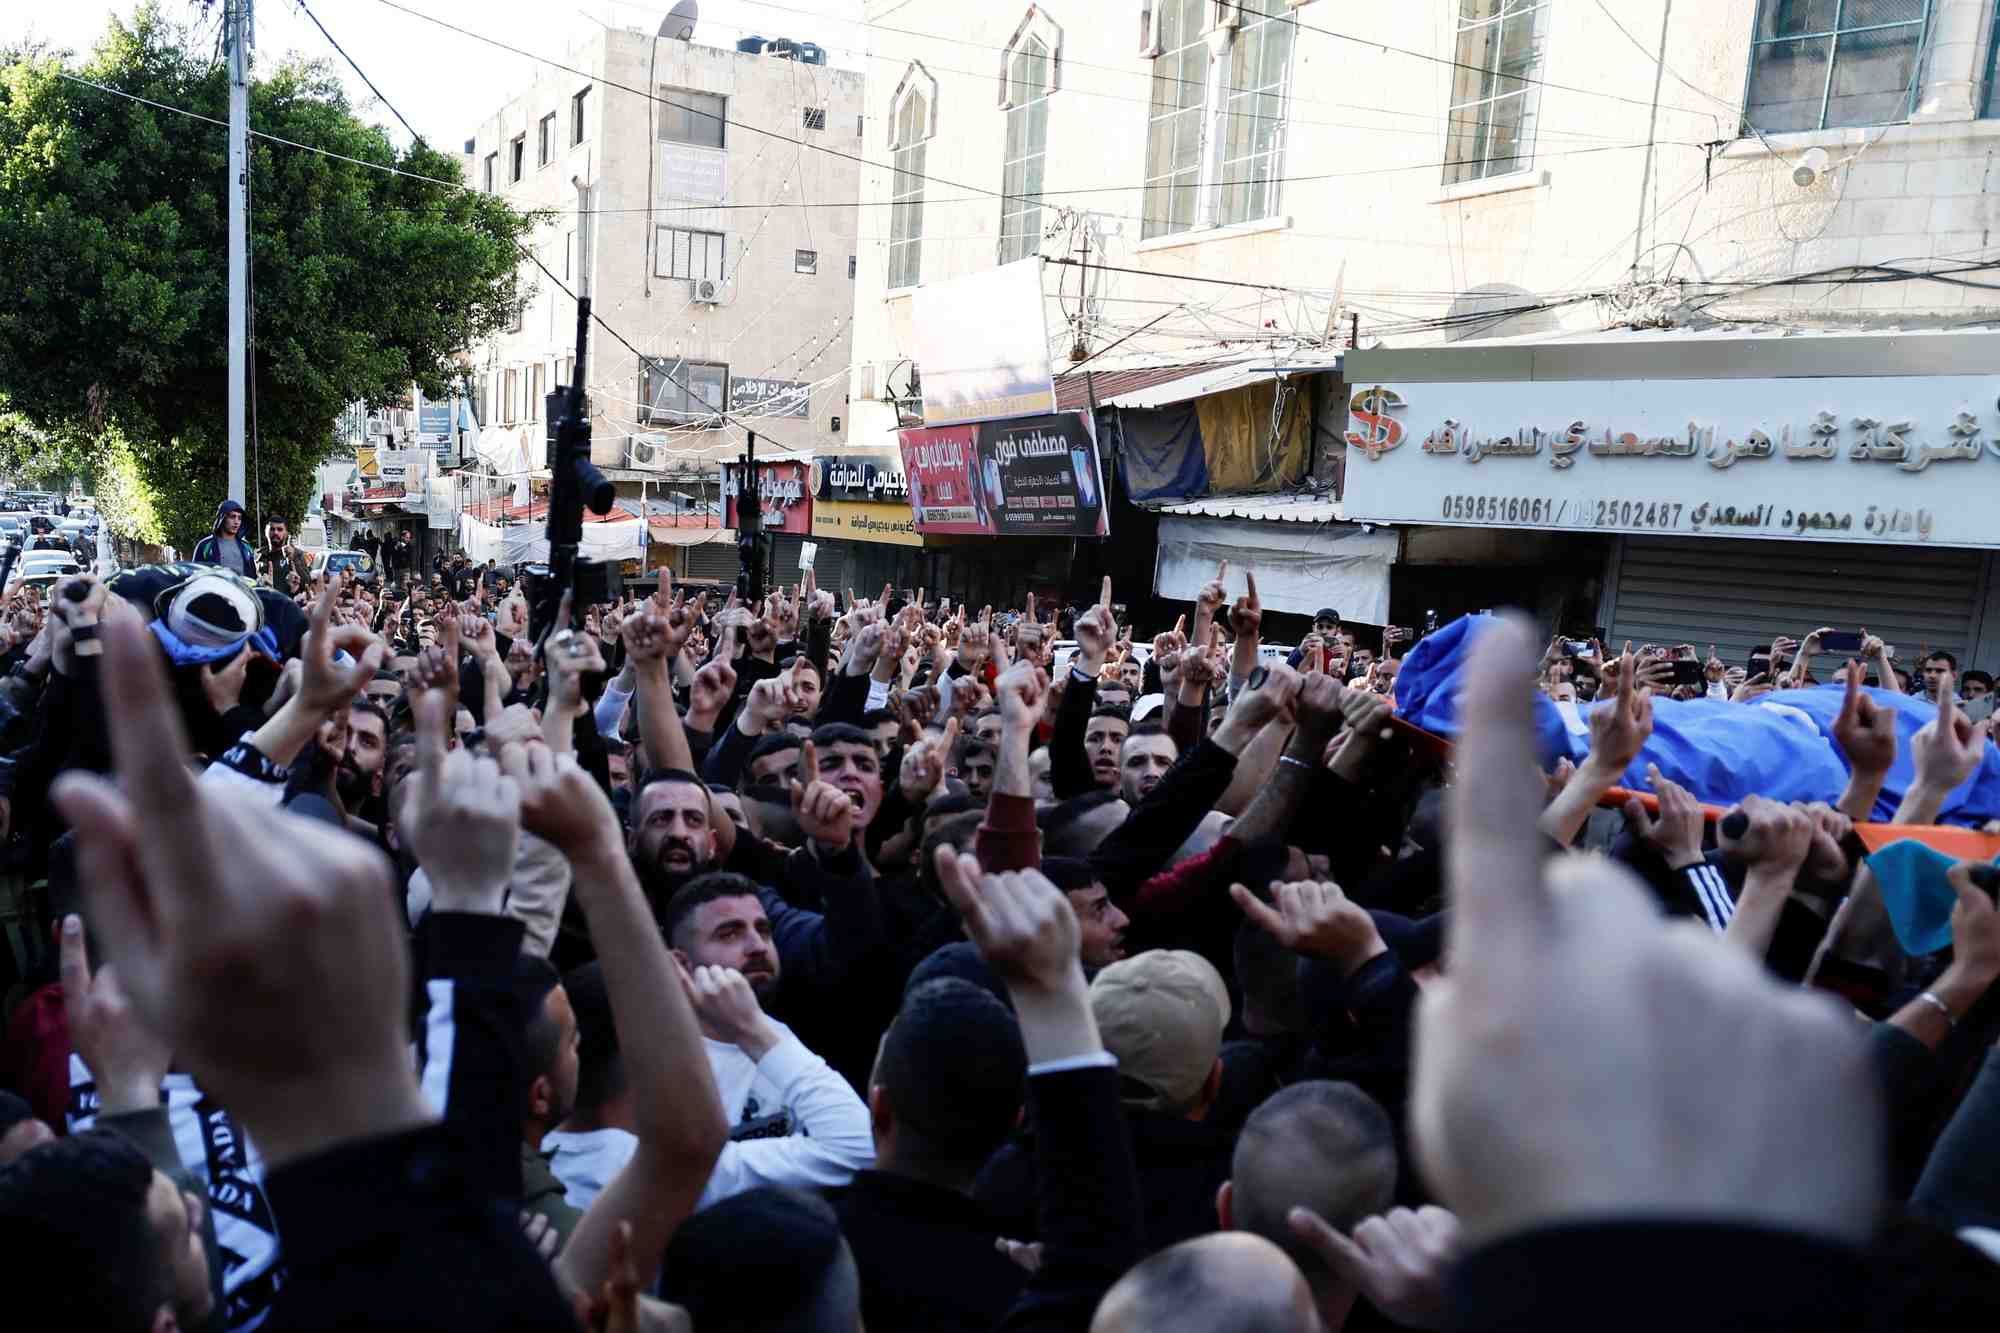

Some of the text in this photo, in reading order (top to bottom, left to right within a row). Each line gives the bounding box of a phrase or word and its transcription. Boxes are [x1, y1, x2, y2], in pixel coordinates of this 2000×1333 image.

[1549, 415, 1718, 469] السعدي
[1706, 410, 1839, 469] شاهر
[1849, 408, 1982, 472] شركة
[829, 463, 866, 495] للصرافة
[1690, 502, 1774, 531] السعدي
[1781, 509, 1852, 535] محمود
